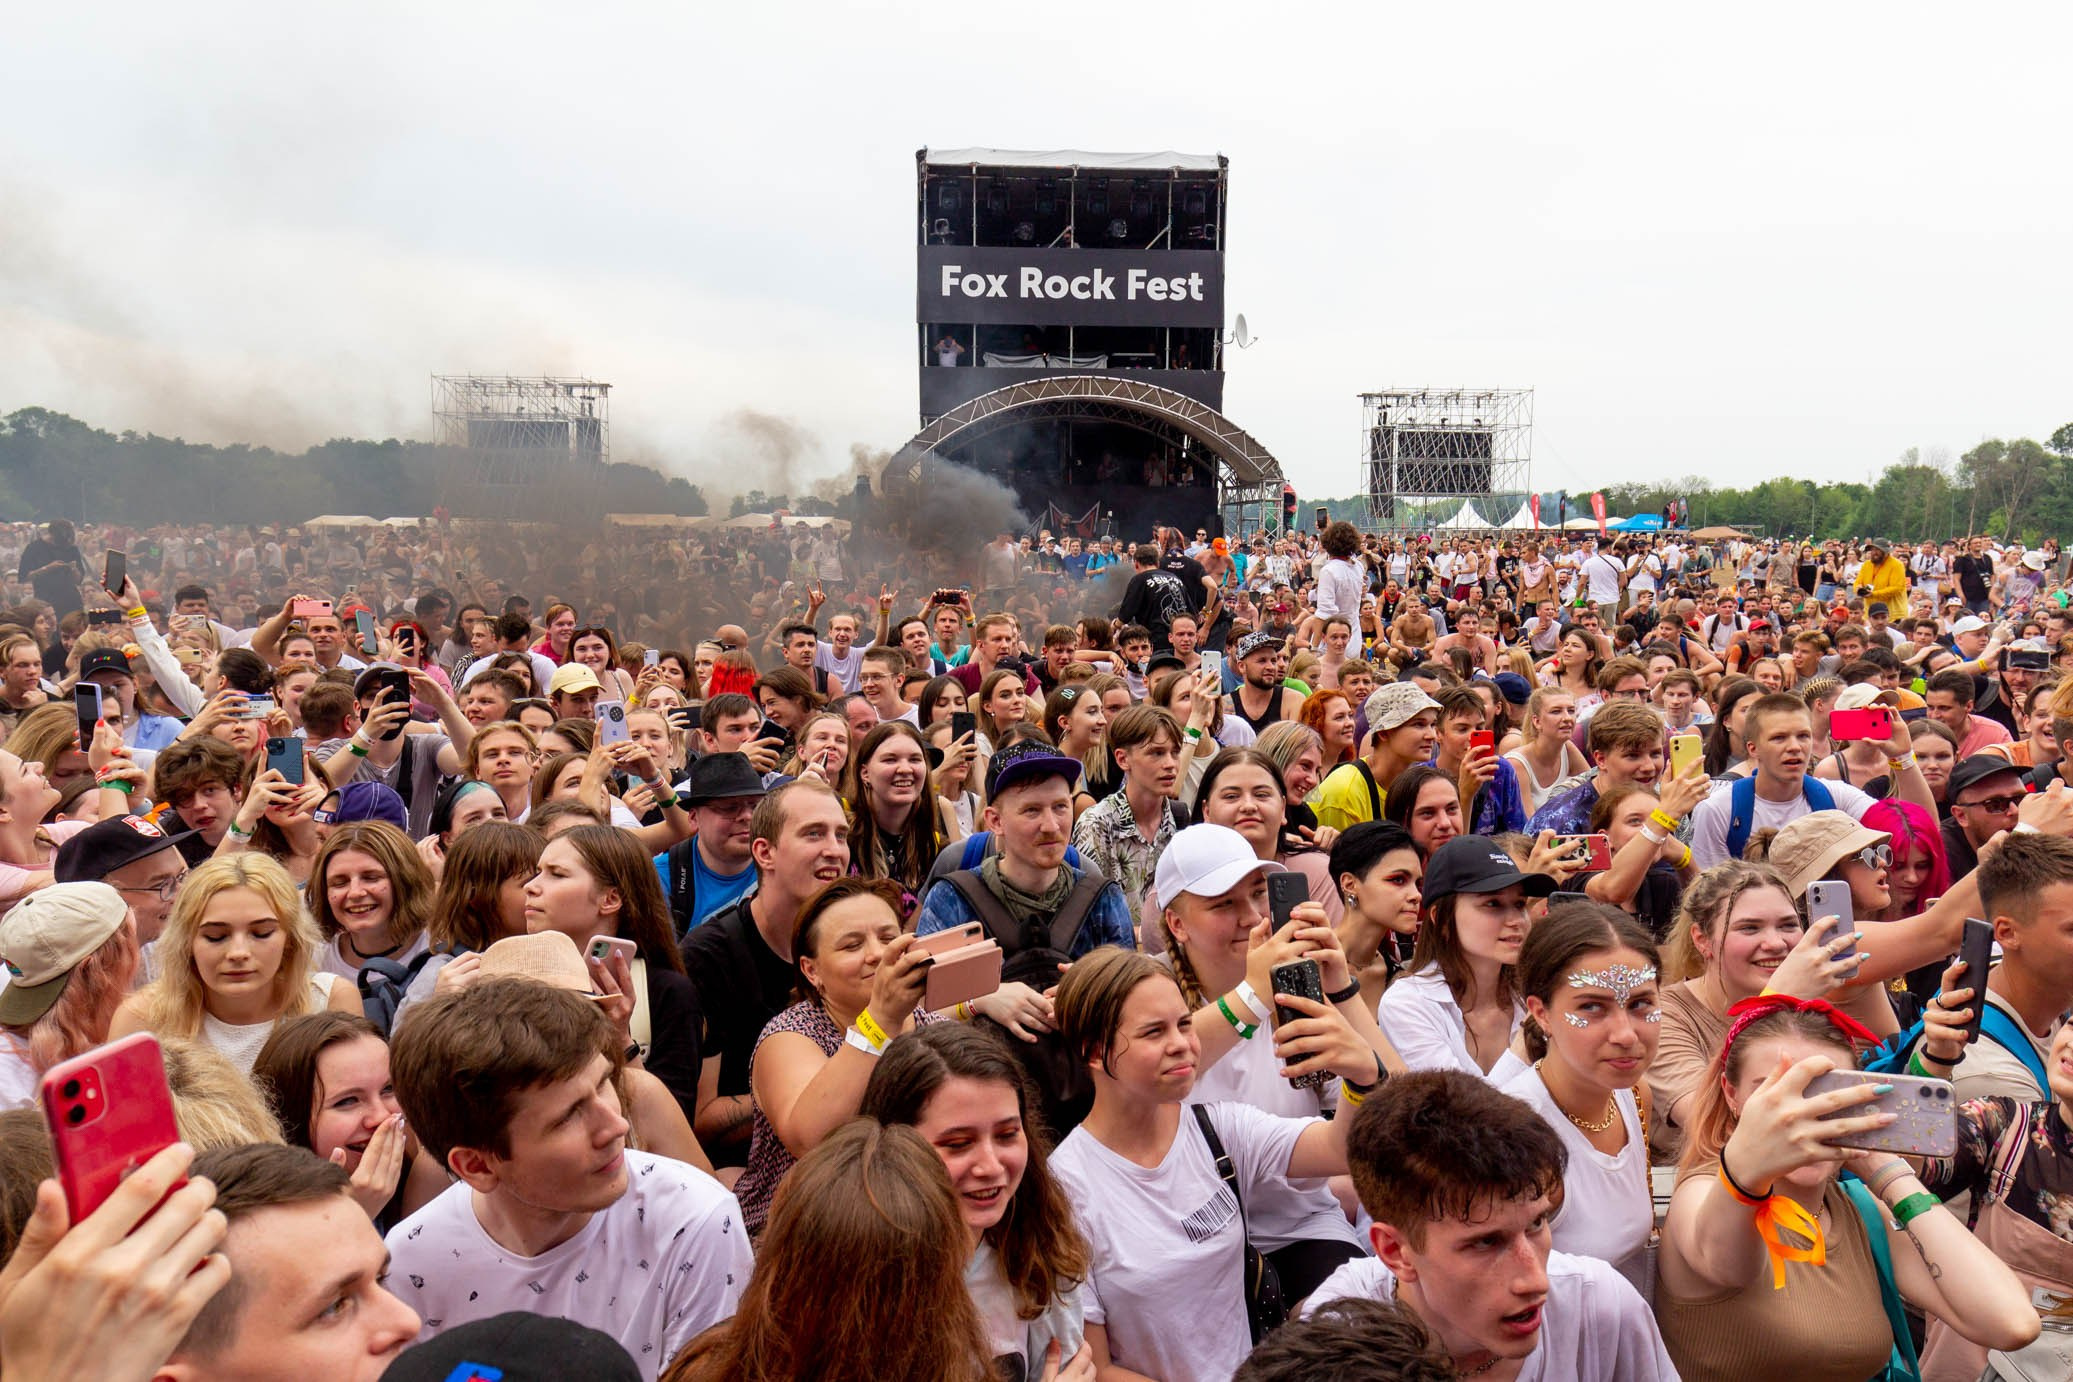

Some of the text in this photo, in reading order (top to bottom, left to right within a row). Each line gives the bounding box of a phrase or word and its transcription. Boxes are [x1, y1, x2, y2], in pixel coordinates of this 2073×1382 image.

[941, 264, 1204, 301] Fox Rock Fest
